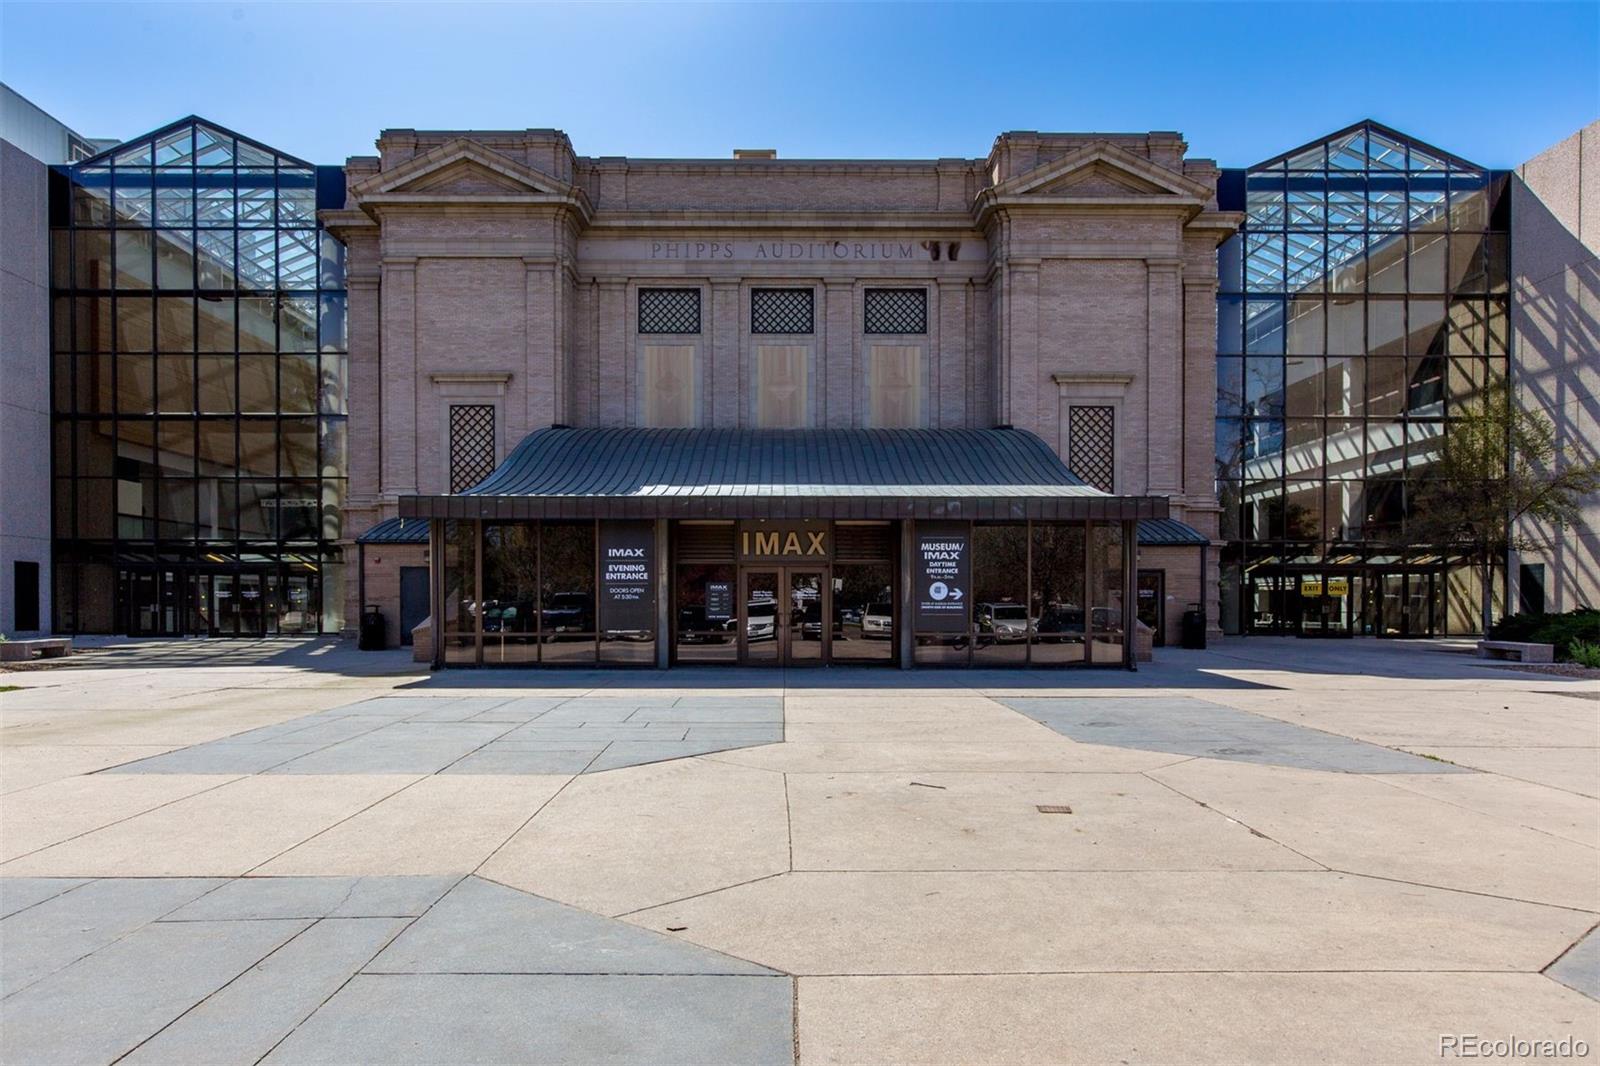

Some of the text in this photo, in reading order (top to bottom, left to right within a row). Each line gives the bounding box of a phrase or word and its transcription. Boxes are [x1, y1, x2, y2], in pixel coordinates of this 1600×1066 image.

[651, 242, 914, 259] PHIPPS AUDITORIUM
[742, 531, 826, 556] IMAX
[921, 543, 964, 551] MUSEUM/
[608, 548, 644, 557] IMAX
[924, 551, 959, 560] IMAX
[608, 564, 645, 572] EVENING
[605, 572, 648, 580] ENTRANCE
